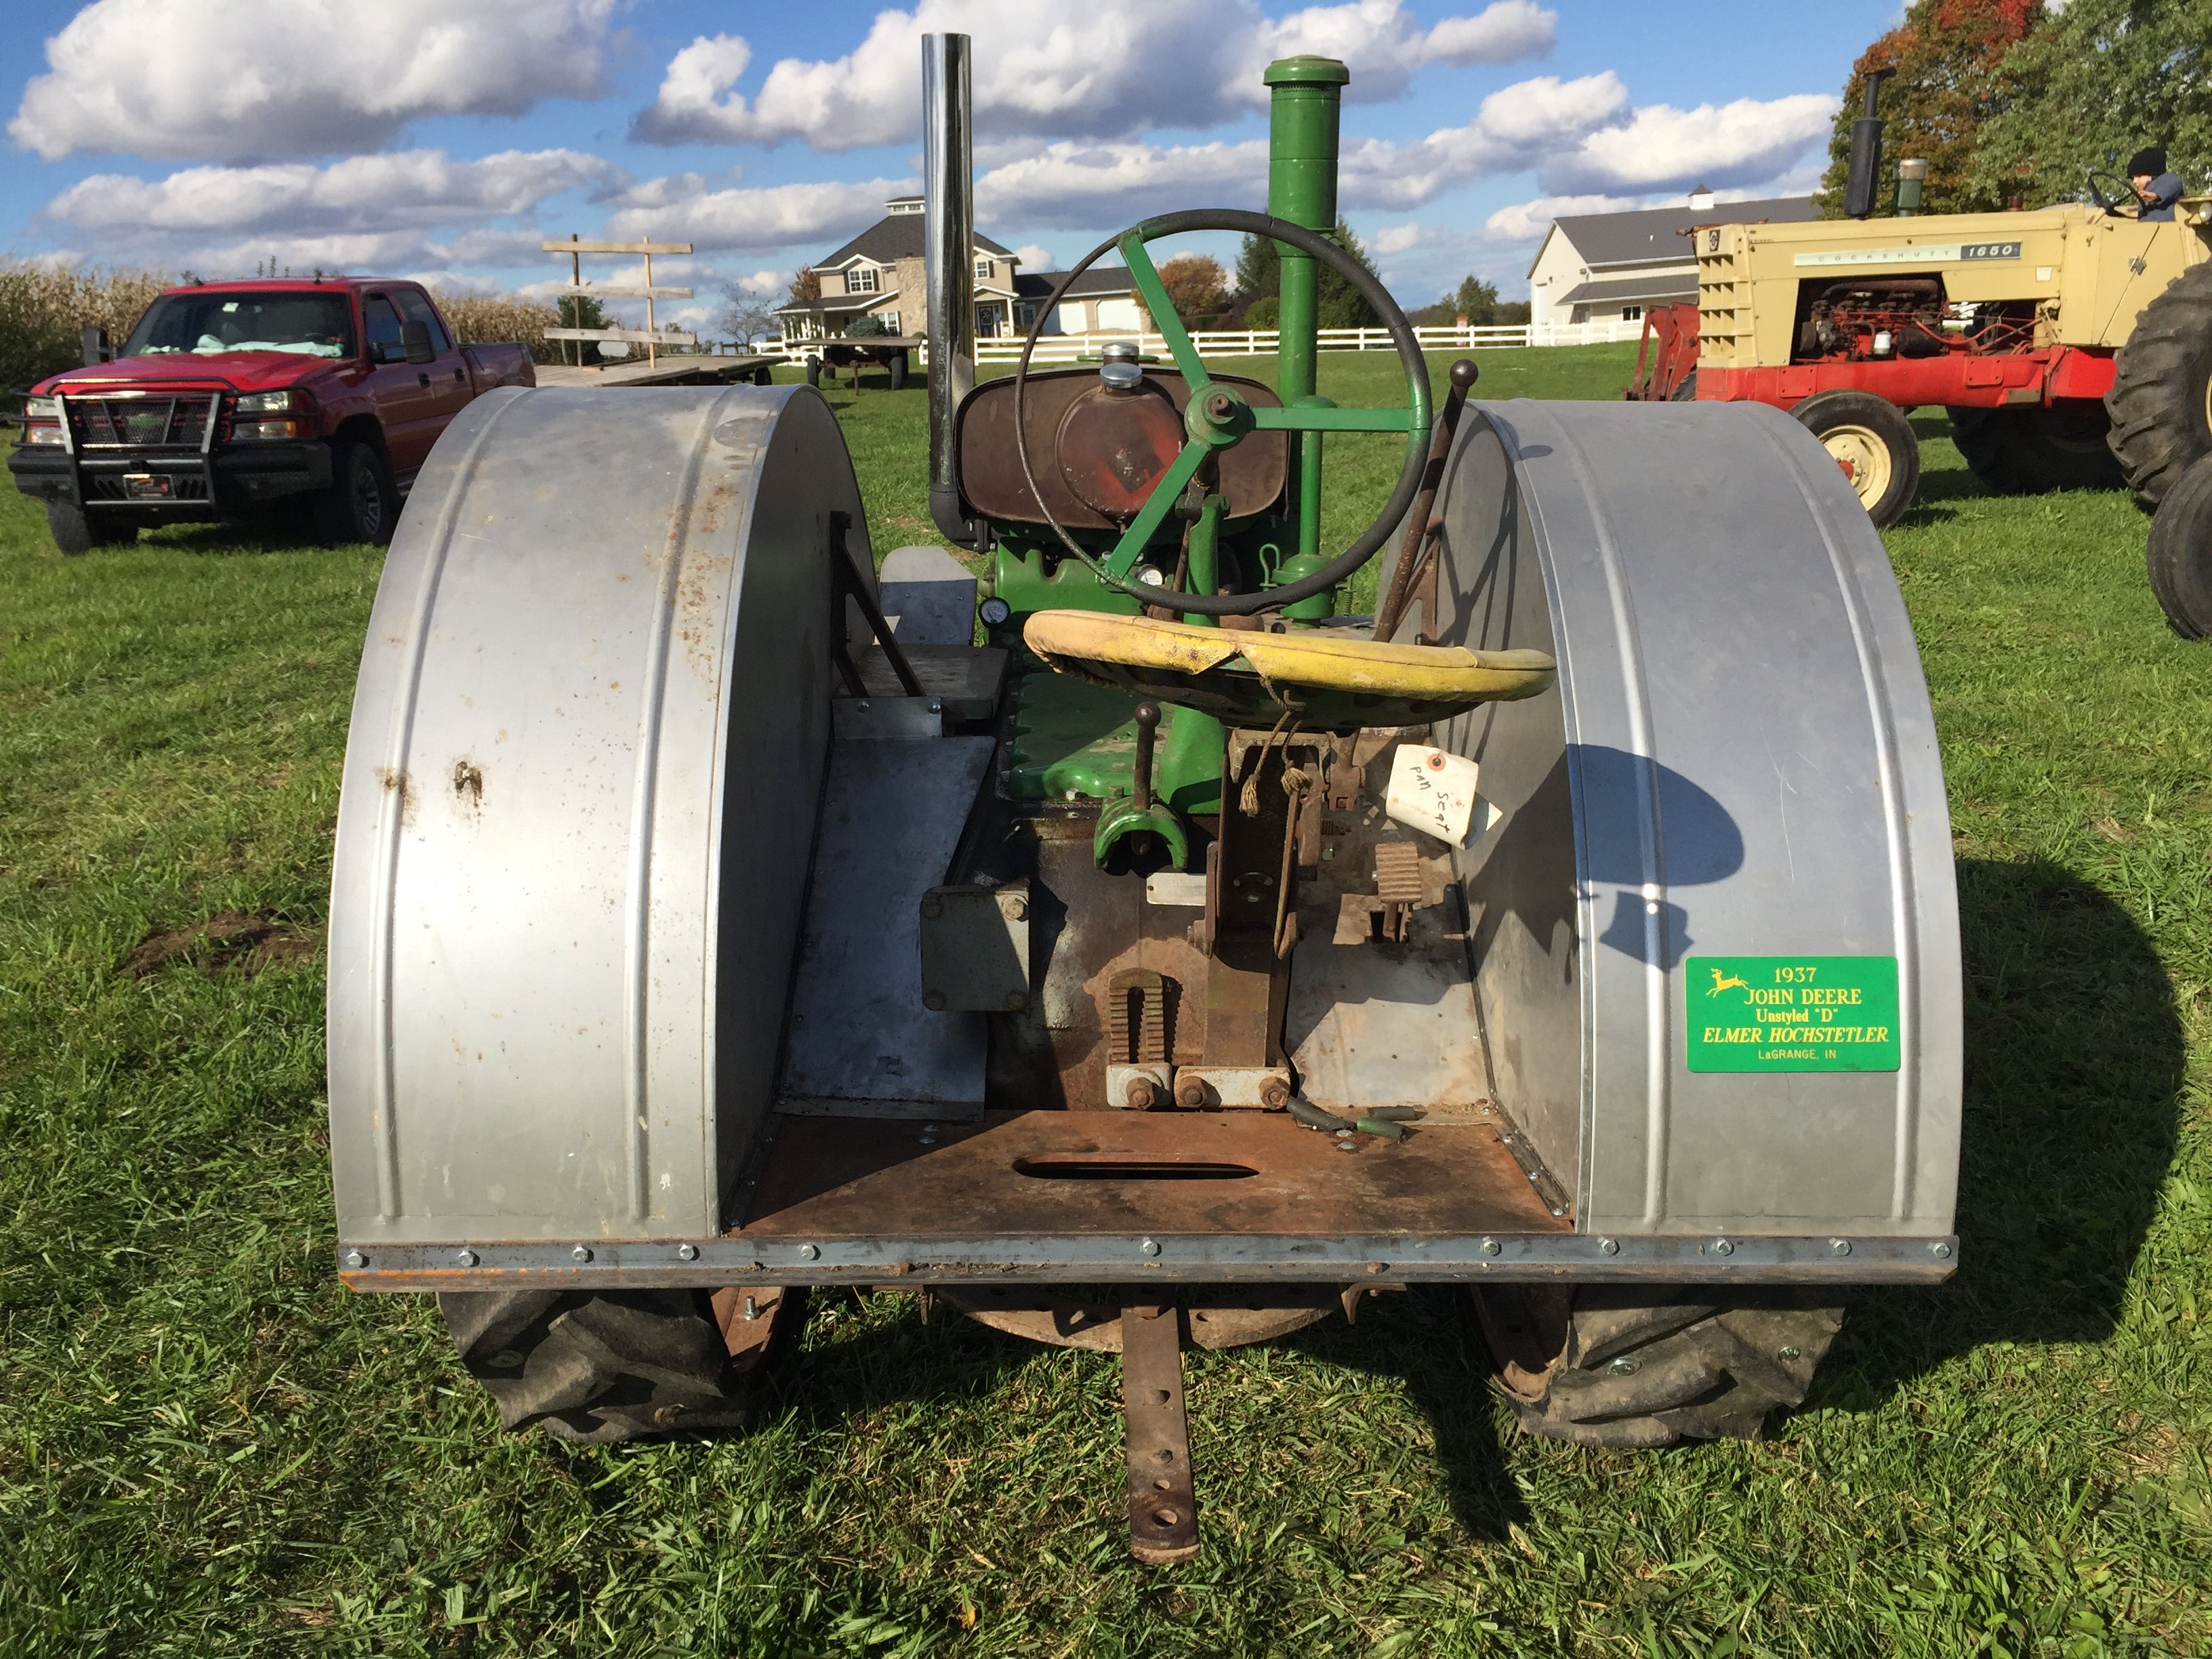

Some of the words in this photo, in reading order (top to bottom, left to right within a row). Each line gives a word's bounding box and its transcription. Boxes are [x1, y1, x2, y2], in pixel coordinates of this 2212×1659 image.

[1818, 250, 1950, 262] COCKSHUTT
[1969, 245, 2013, 257] 1650
[1774, 967, 1817, 983] 1937
[1744, 989, 1794, 1005] JOHN
[1801, 989, 1862, 1004] DEERE
[1756, 1008, 1809, 1025] Unstyled
[1815, 1008, 1839, 1023] "D"
[1703, 1027, 1763, 1043] ELMER
[1768, 1027, 1889, 1043] HOCHSTETLER
[1758, 1049, 1819, 1060] LaGRANGE,
[1825, 1049, 1837, 1059] IN
